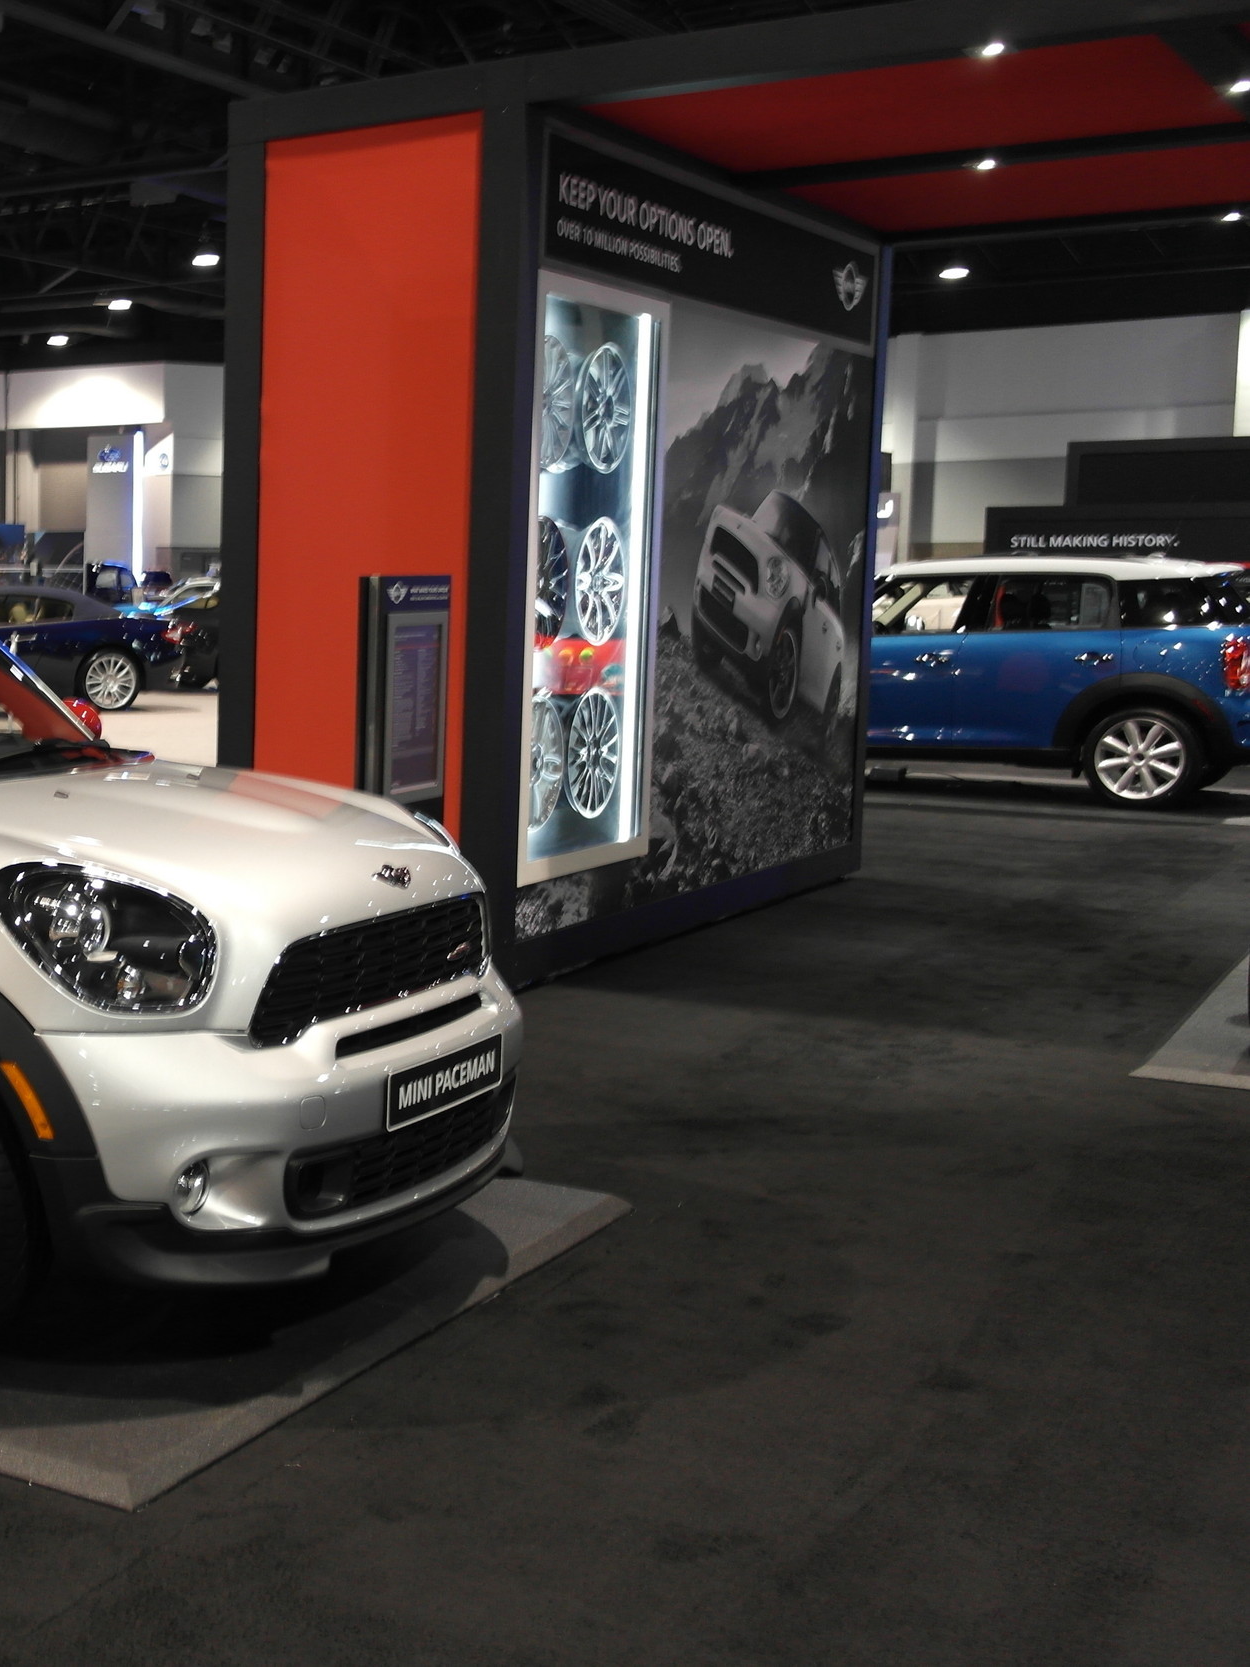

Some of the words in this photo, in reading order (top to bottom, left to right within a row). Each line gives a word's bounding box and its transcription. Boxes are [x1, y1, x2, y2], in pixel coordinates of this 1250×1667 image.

[558, 172, 596, 212] KEEP
[597, 186, 638, 227] YOUR
[639, 200, 697, 247] OPTIONS
[697, 220, 735, 258] OPEN.
[556, 217, 581, 242] OVER
[582, 226, 593, 247] 10
[594, 229, 628, 257] MILLION
[629, 239, 682, 273] POSSIBILITIES.
[1009, 533, 1047, 548] STILL
[1049, 533, 1110, 548] MAKING
[1112, 533, 1180, 547] HISTORY.
[398, 1074, 432, 1110] MINI
[435, 1049, 496, 1096] PACEMAN
